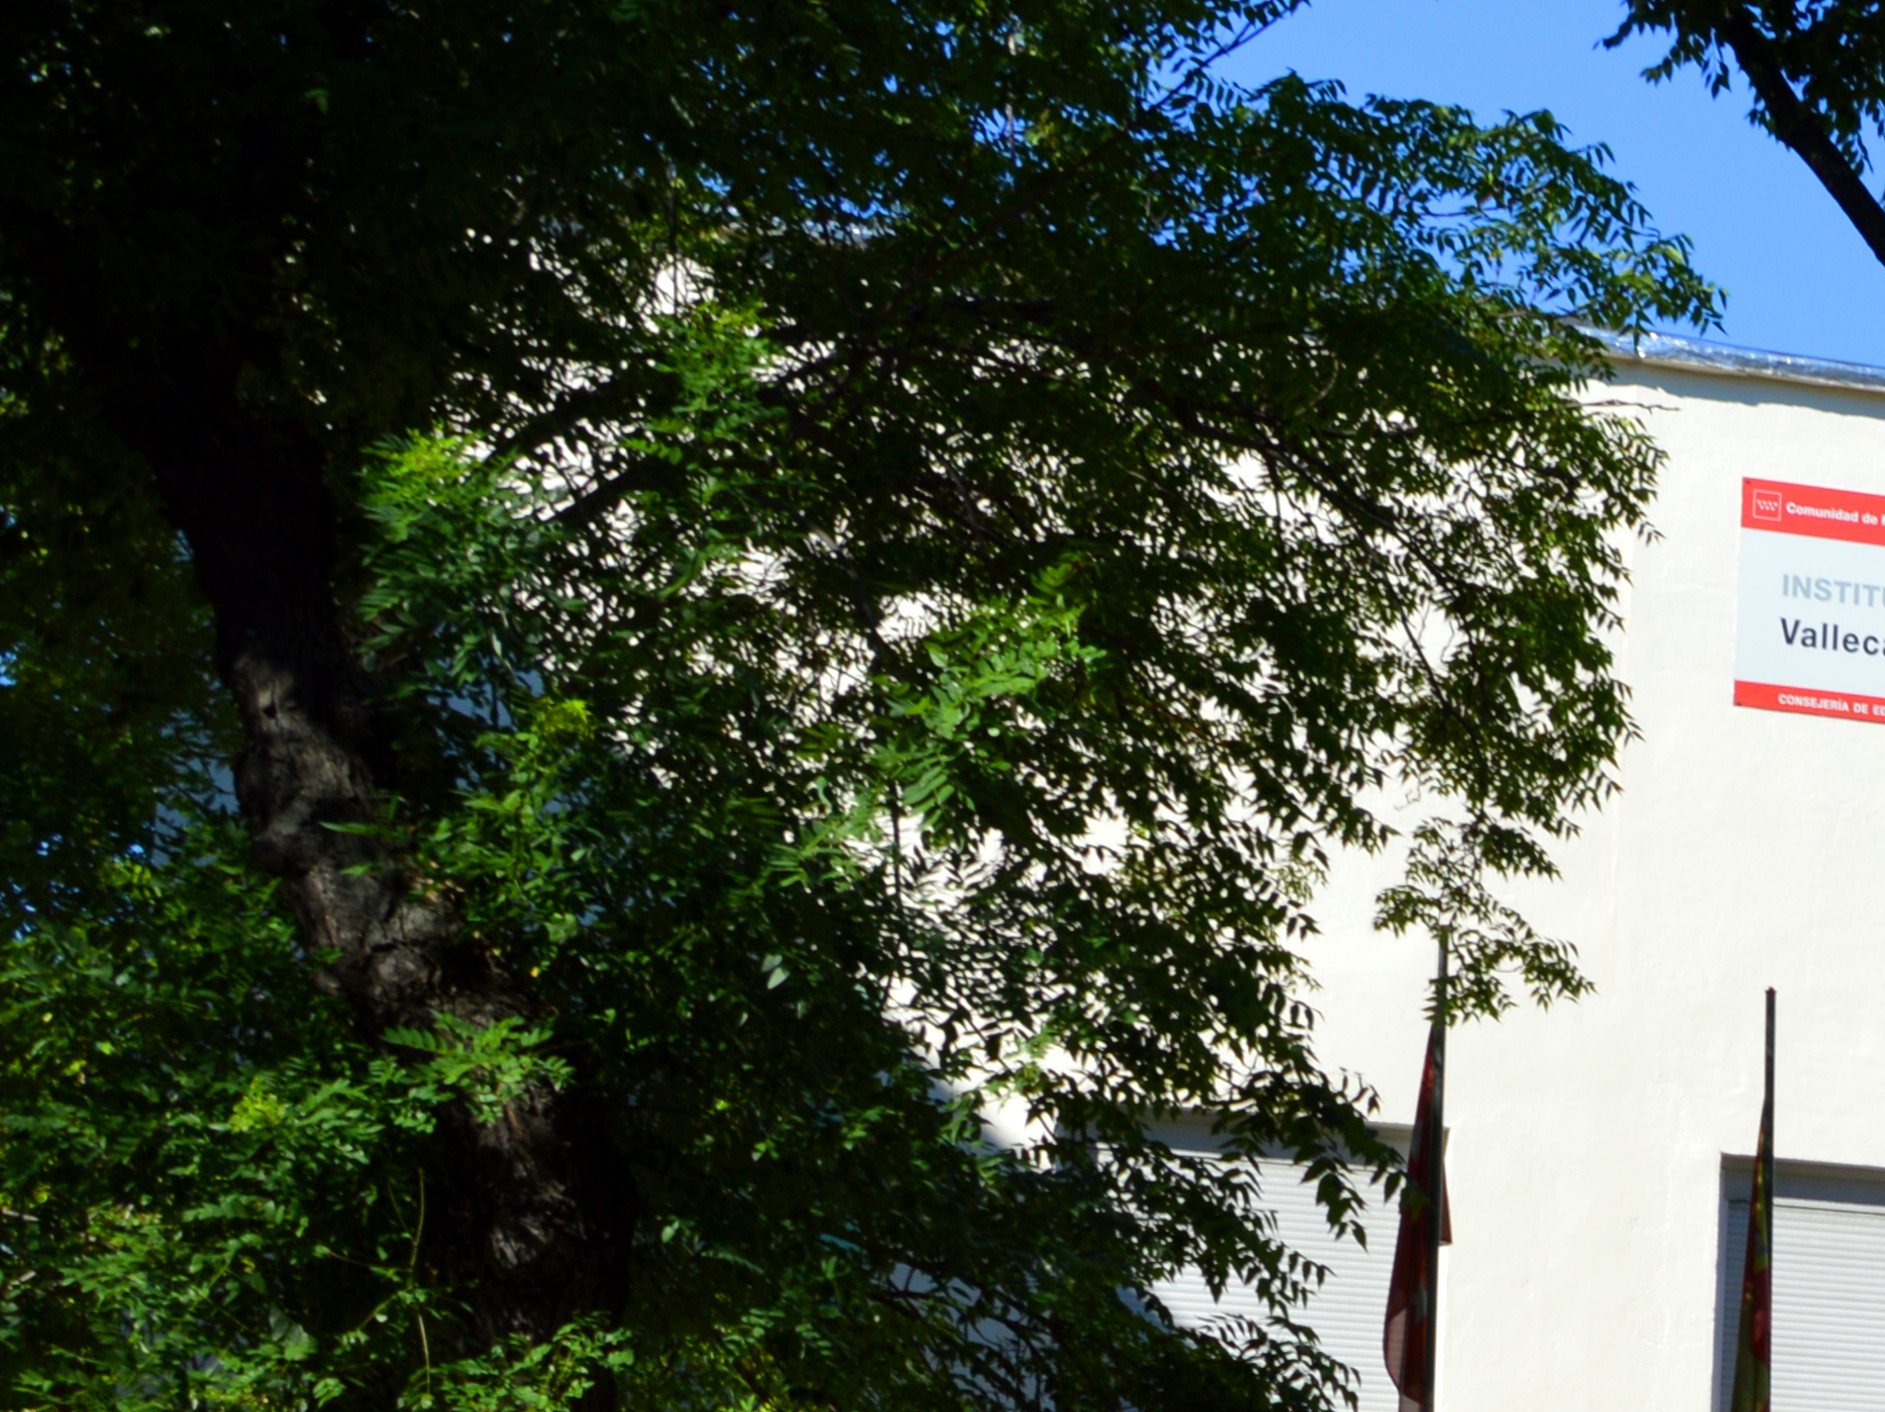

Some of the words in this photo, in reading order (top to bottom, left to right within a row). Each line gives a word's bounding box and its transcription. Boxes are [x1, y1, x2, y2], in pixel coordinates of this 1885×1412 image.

[1786, 502, 1859, 523] Comunidad
[1862, 513, 1878, 525] de
[1778, 693, 1849, 712] CONSEJERÍA
[1853, 702, 1868, 714] DE
